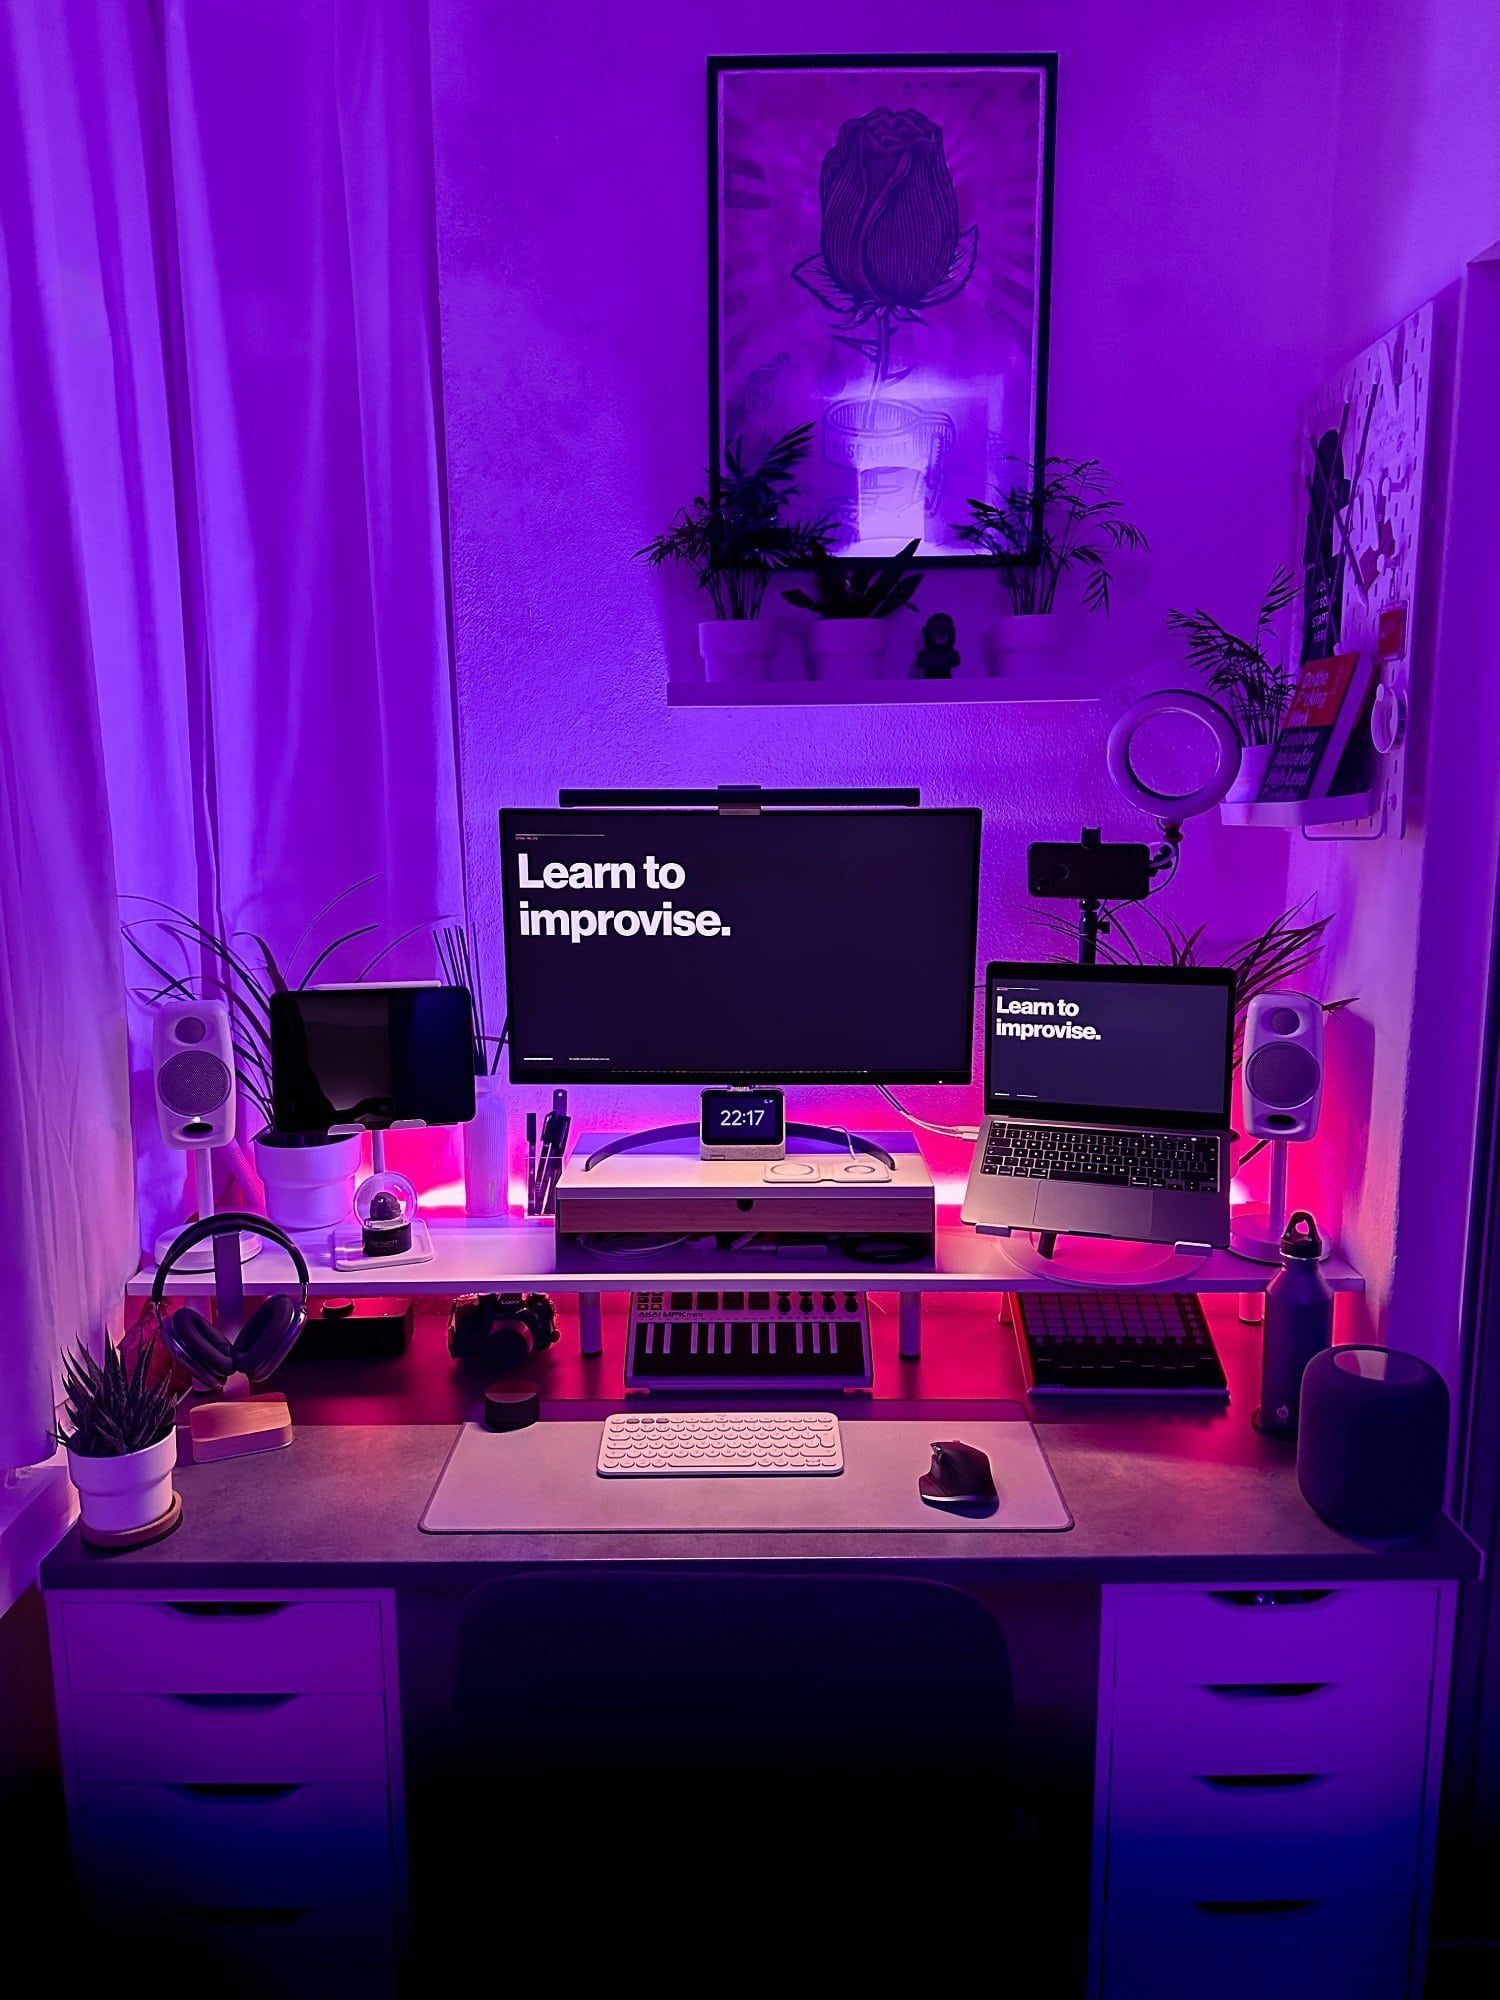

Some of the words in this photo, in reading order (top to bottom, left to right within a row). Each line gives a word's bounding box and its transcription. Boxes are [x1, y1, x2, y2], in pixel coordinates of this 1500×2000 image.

[517, 852, 636, 890] Learn
[642, 855, 686, 890] to
[519, 900, 731, 944] improvise.
[996, 995, 1055, 1016] Learn
[1056, 999, 1080, 1017] to
[995, 1017, 1102, 1041] improvise.
[720, 1109, 765, 1126] 22:17
